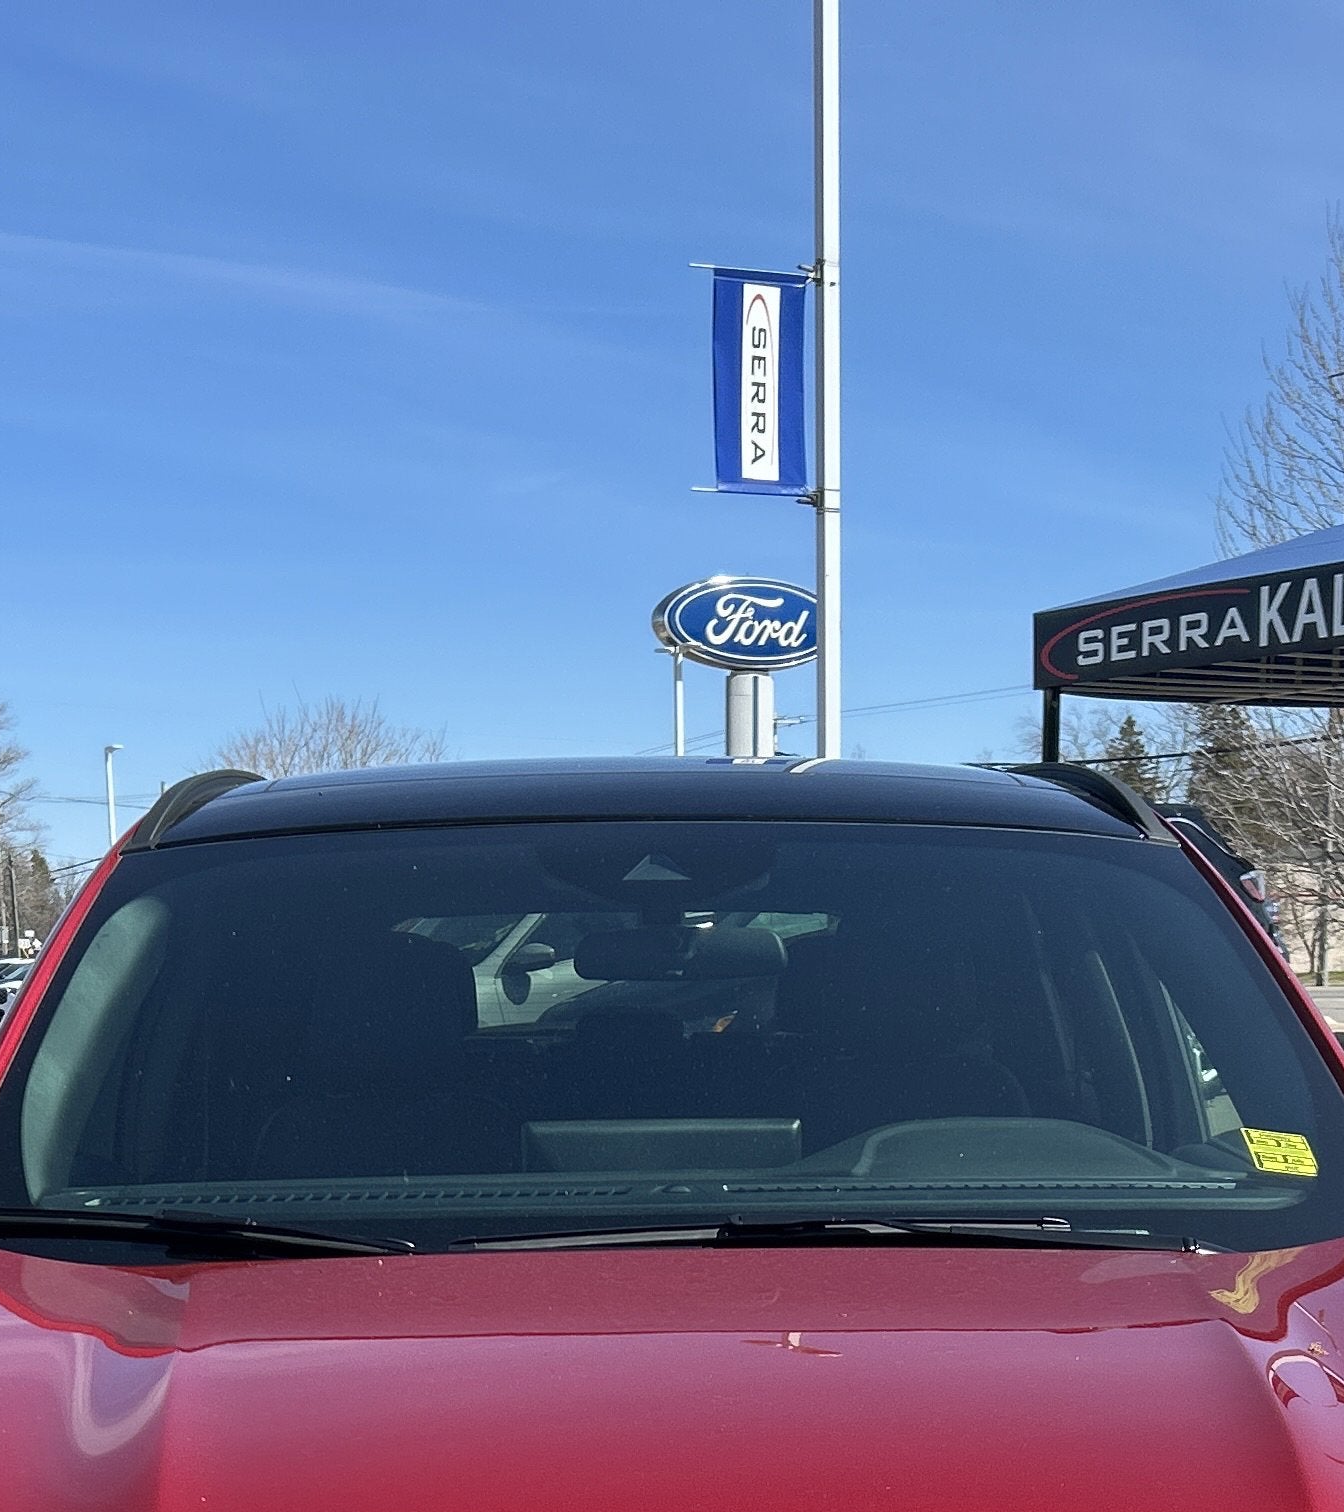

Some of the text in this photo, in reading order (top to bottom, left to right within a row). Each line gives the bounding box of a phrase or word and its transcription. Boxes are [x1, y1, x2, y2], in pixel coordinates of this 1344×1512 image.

[750, 325, 768, 466] SERRA
[705, 592, 811, 648] Ford
[1076, 606, 1251, 667] SERRA
